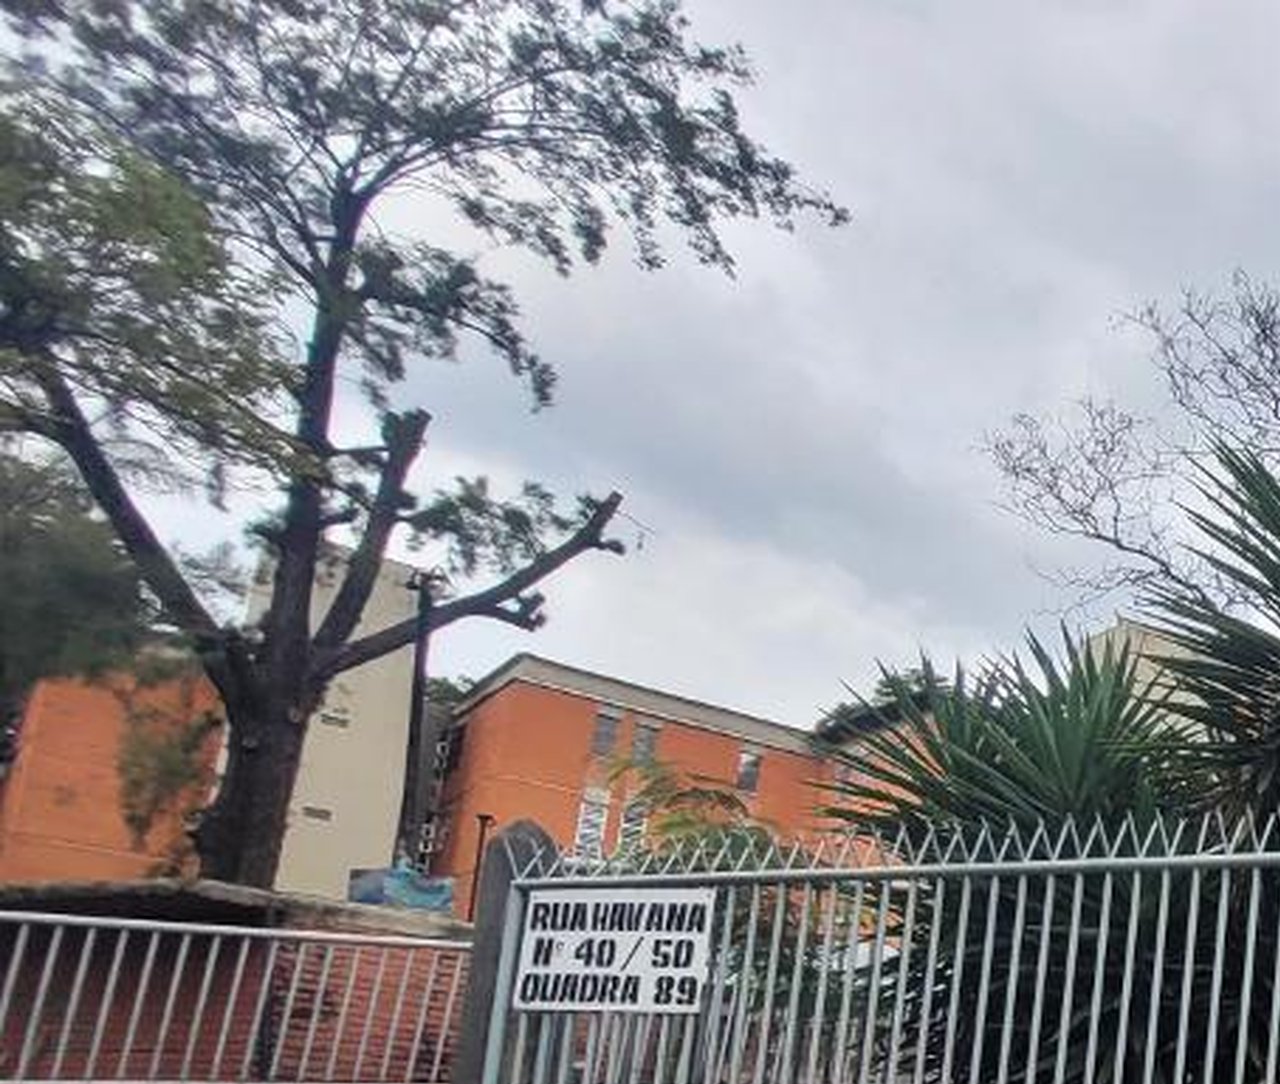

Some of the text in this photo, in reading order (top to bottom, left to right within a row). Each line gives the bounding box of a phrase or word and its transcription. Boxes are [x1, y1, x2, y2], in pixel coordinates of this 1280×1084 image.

[530, 902, 707, 932] RUA HAVANA
[519, 973, 698, 1005] QUADRA 89
